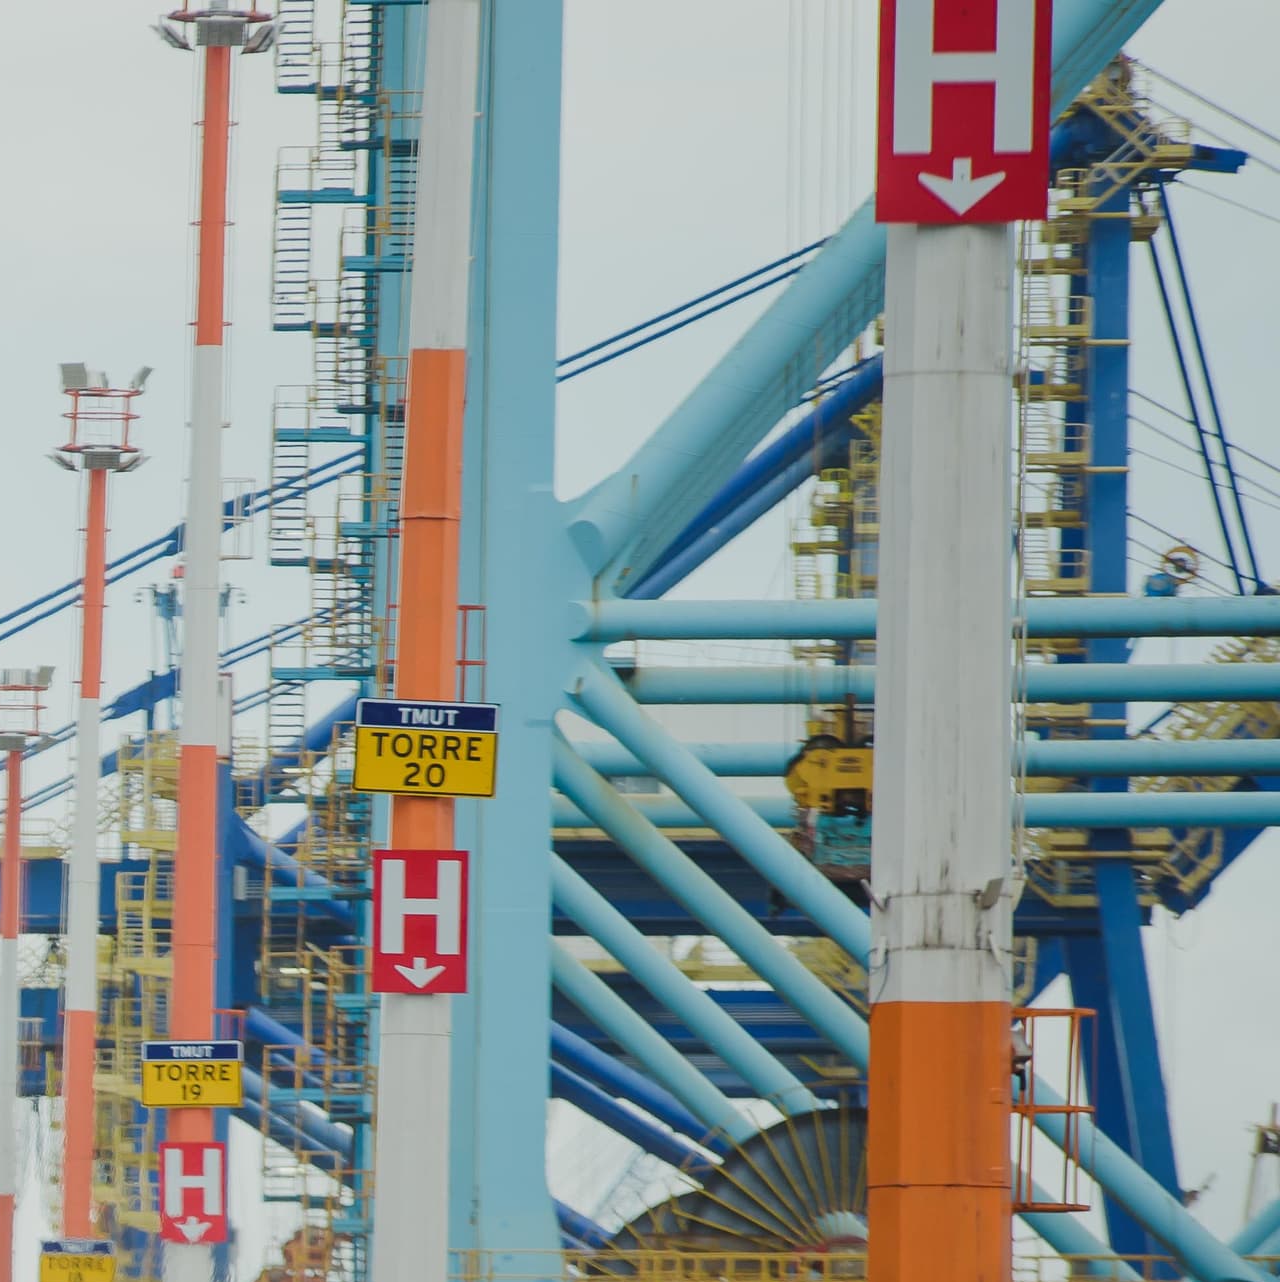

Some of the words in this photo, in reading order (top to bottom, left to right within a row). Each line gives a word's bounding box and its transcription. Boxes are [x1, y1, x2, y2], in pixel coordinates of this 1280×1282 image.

[893, 0, 1034, 154] H
[398, 706, 459, 726] TMUT
[374, 733, 482, 761] TORRE
[403, 763, 446, 788] 20
[379, 858, 460, 956] H
[170, 1045, 214, 1058] TMUT
[153, 1063, 230, 1082] TORRE
[180, 1083, 202, 1101] 19
[163, 1148, 223, 1216] H
[47, 1256, 107, 1272] TORRE
